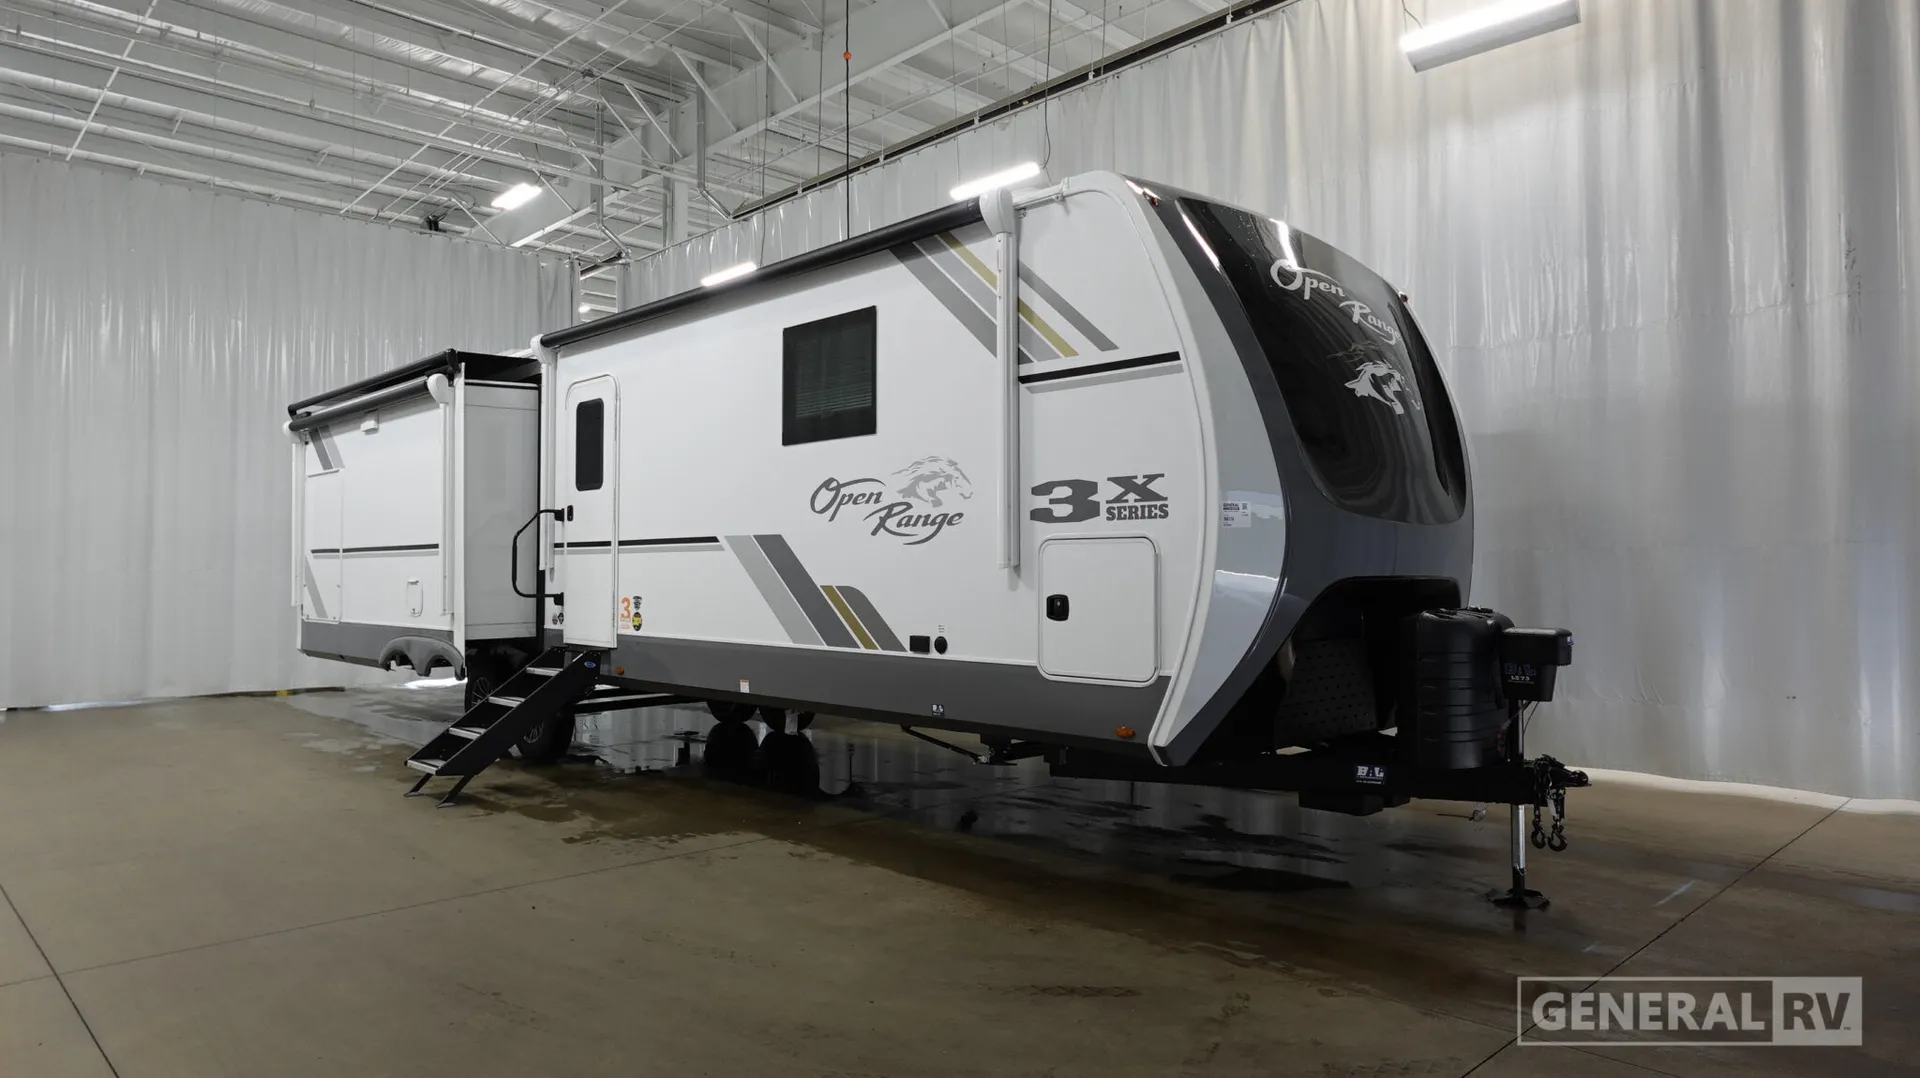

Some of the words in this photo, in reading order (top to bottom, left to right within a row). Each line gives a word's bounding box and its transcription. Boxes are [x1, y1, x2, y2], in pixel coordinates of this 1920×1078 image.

[1270, 258, 1346, 301] Open
[1339, 300, 1402, 345] Range
[810, 477, 886, 522] Open
[1105, 503, 1169, 521] SERIES
[863, 501, 964, 545] Range
